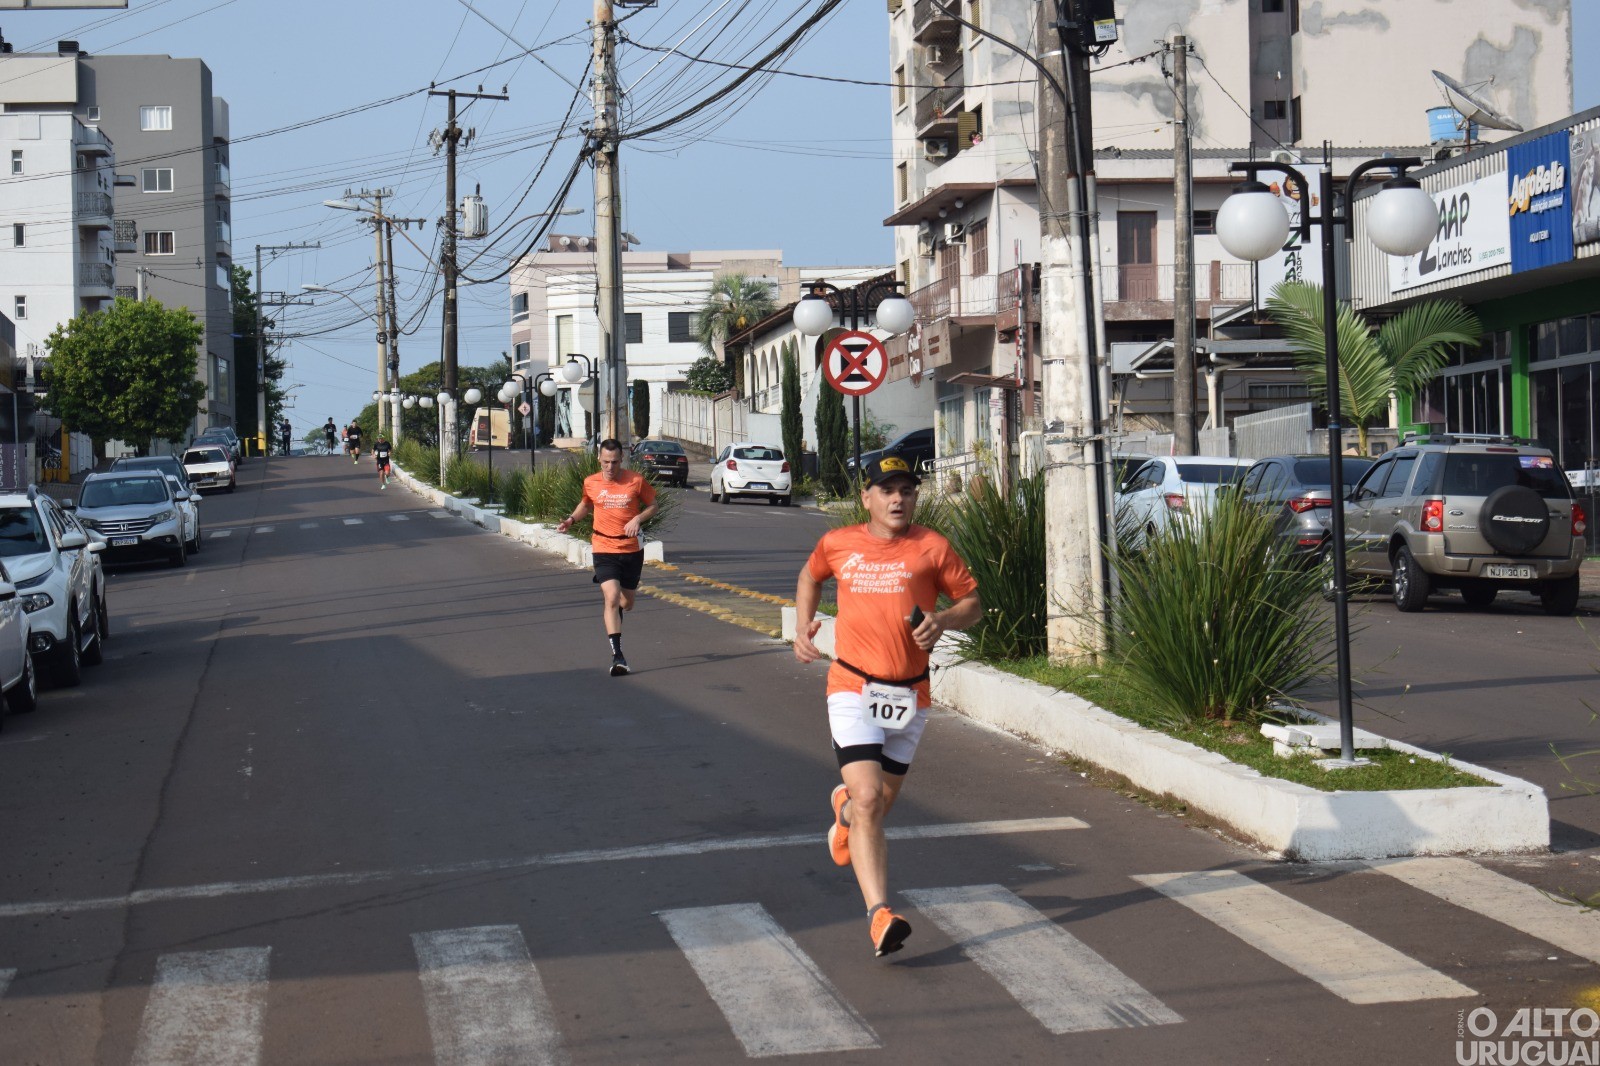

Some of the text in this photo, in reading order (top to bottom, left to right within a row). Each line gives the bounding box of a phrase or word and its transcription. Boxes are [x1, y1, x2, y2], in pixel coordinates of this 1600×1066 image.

[1509, 161, 1565, 209] AgroBella
[1437, 242, 1472, 272] Lanches
[857, 562, 905, 572] RÚSTICA
[852, 572, 877, 580] ANOS
[879, 570, 912, 580] UNOPAR
[853, 579, 900, 587] FREDERICO
[850, 585, 905, 594] WESTPHALEN
[869, 702, 907, 721] 107
